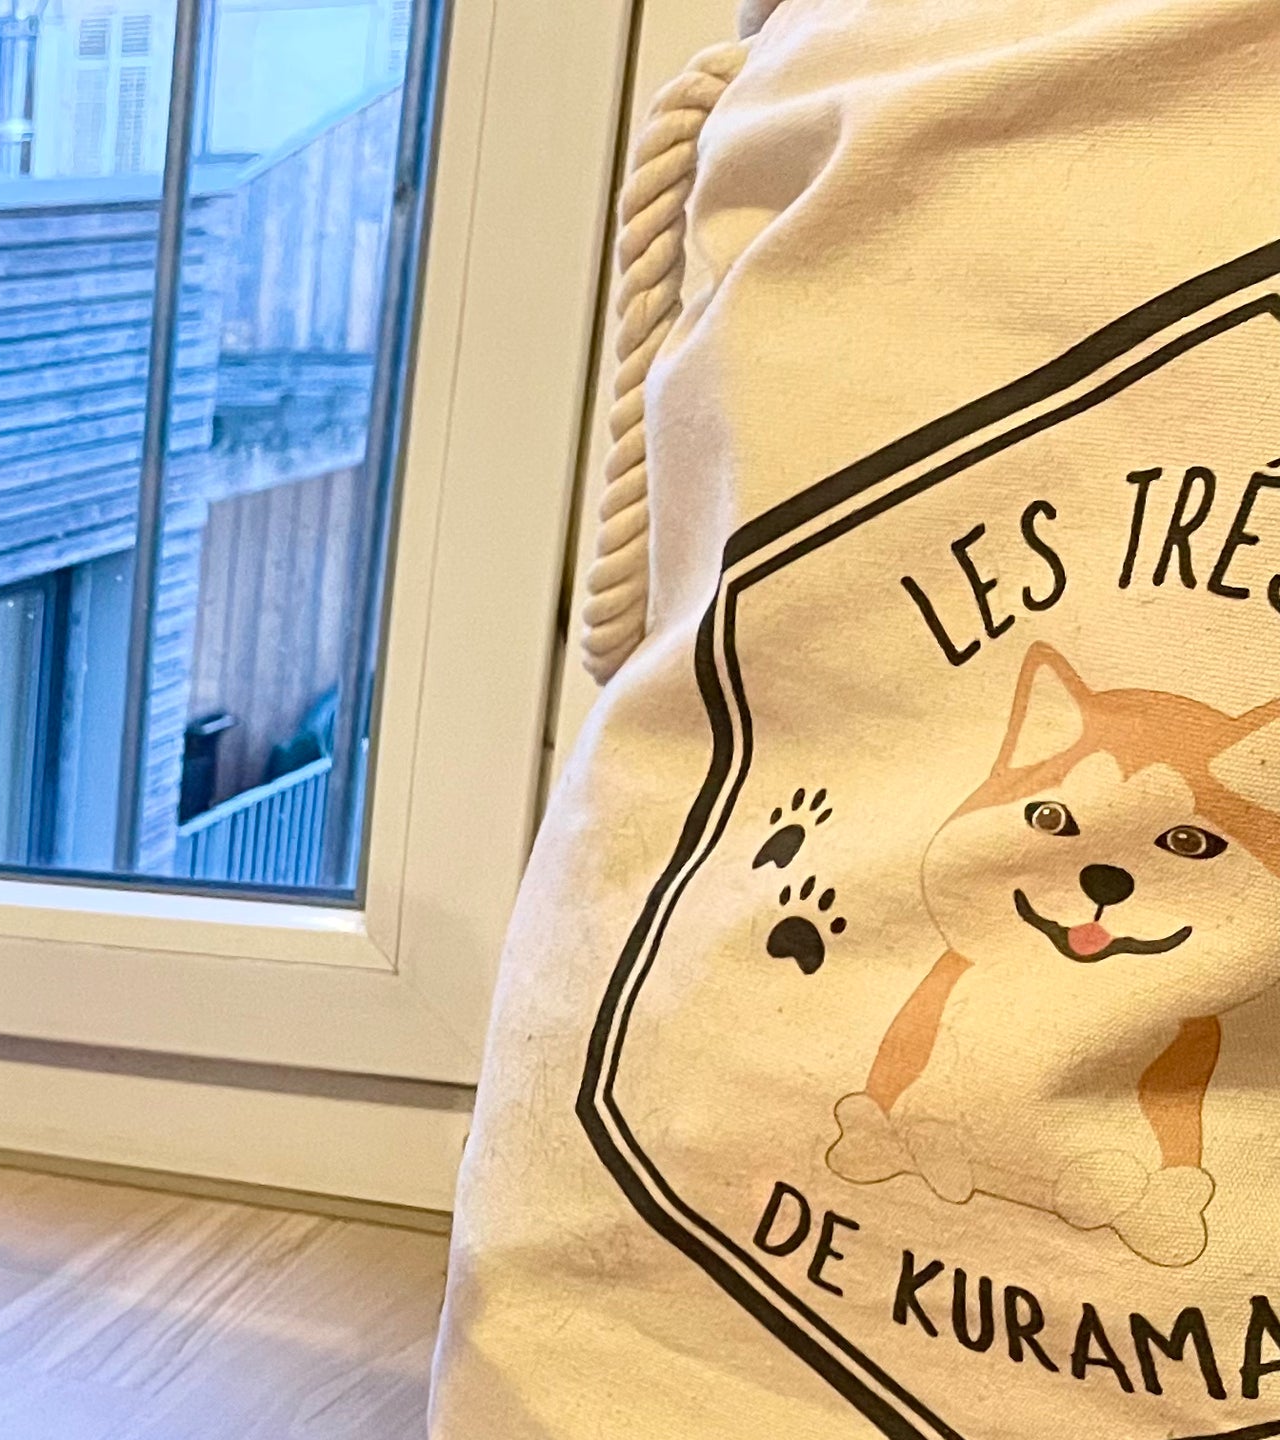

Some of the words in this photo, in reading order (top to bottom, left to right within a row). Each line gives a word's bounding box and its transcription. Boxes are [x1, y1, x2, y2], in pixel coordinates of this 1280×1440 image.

[901, 501, 1066, 666] LES
[753, 1181, 860, 1296] DE
[892, 1250, 1280, 1399] KURAMA
